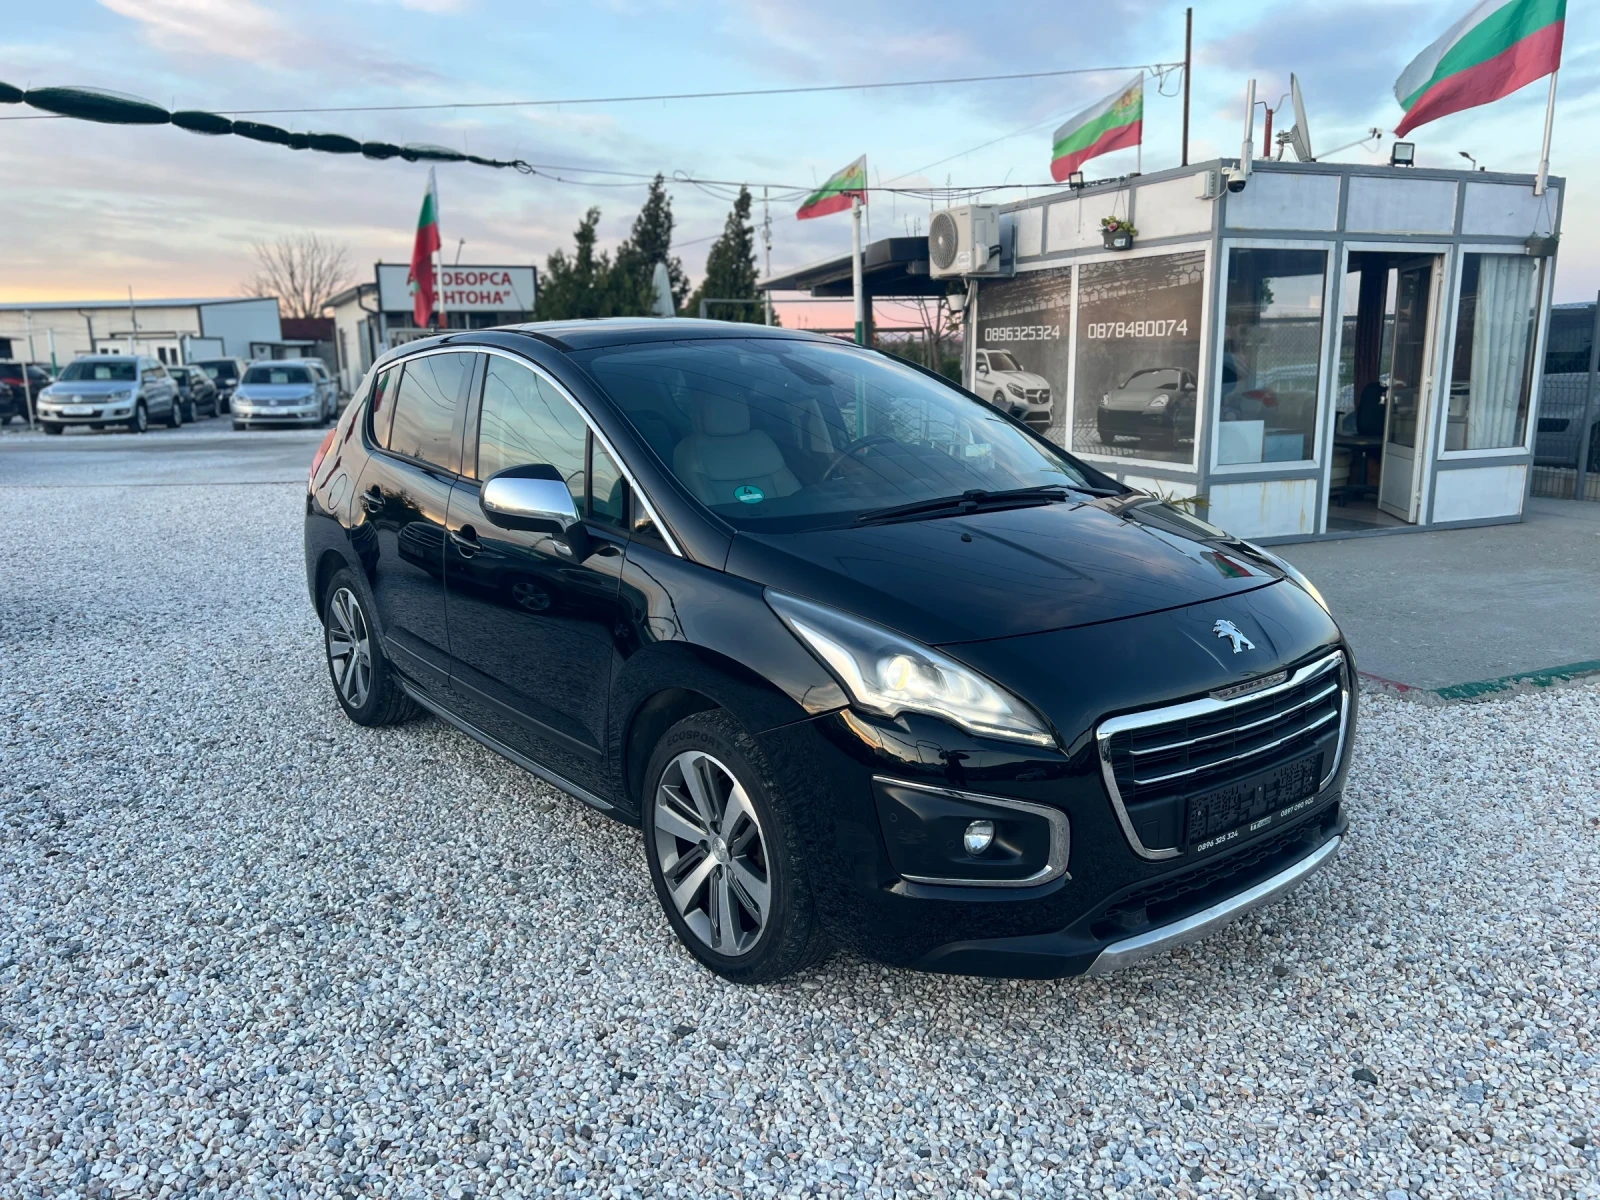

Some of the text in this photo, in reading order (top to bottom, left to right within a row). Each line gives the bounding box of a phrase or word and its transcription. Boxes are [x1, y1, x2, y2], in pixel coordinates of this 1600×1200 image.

[985, 325, 1060, 342] 0896325324
[1088, 319, 1188, 339] 0878480074
[1197, 840, 1214, 852] 0896
[1215, 834, 1226, 845] 325
[1227, 830, 1239, 840] 324
[1280, 806, 1294, 818] 0897
